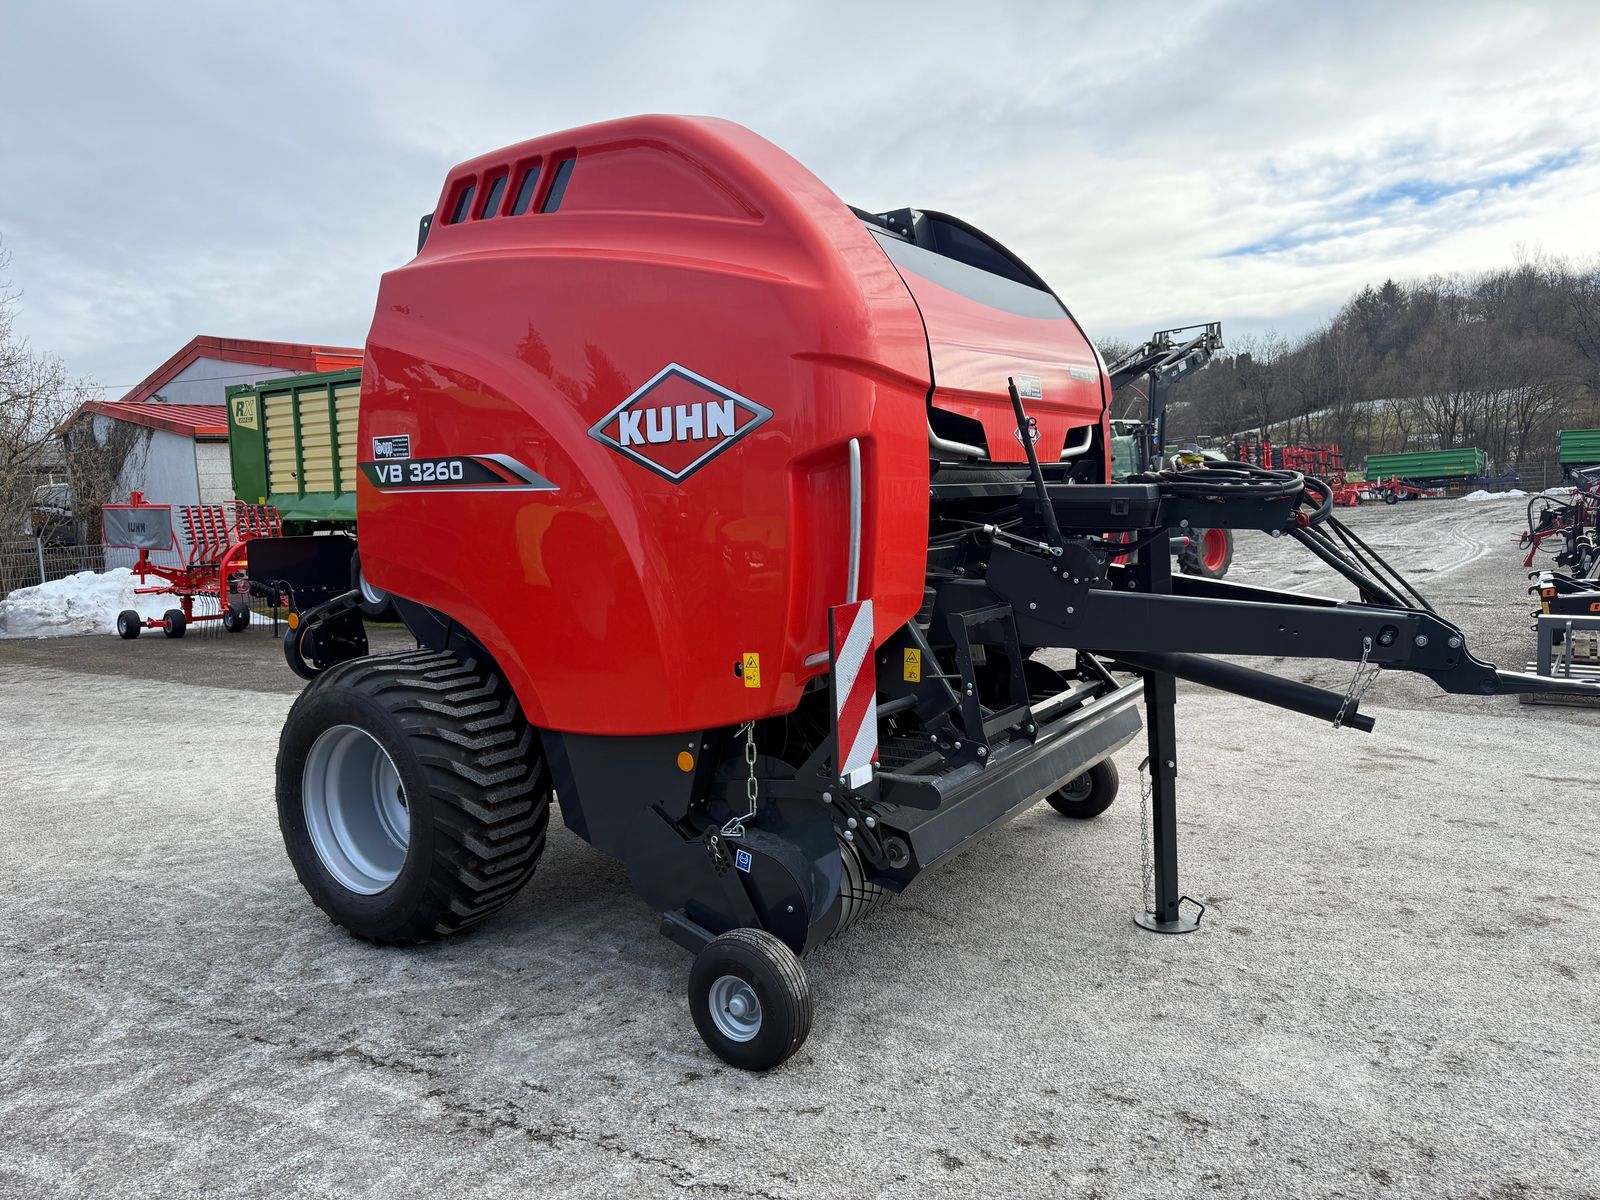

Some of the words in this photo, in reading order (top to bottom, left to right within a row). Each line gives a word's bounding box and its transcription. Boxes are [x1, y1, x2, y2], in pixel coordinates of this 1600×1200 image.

[236, 400, 254, 417] RX
[618, 399, 735, 447] KUHN
[374, 464, 403, 483] VB
[409, 461, 463, 482] 3260
